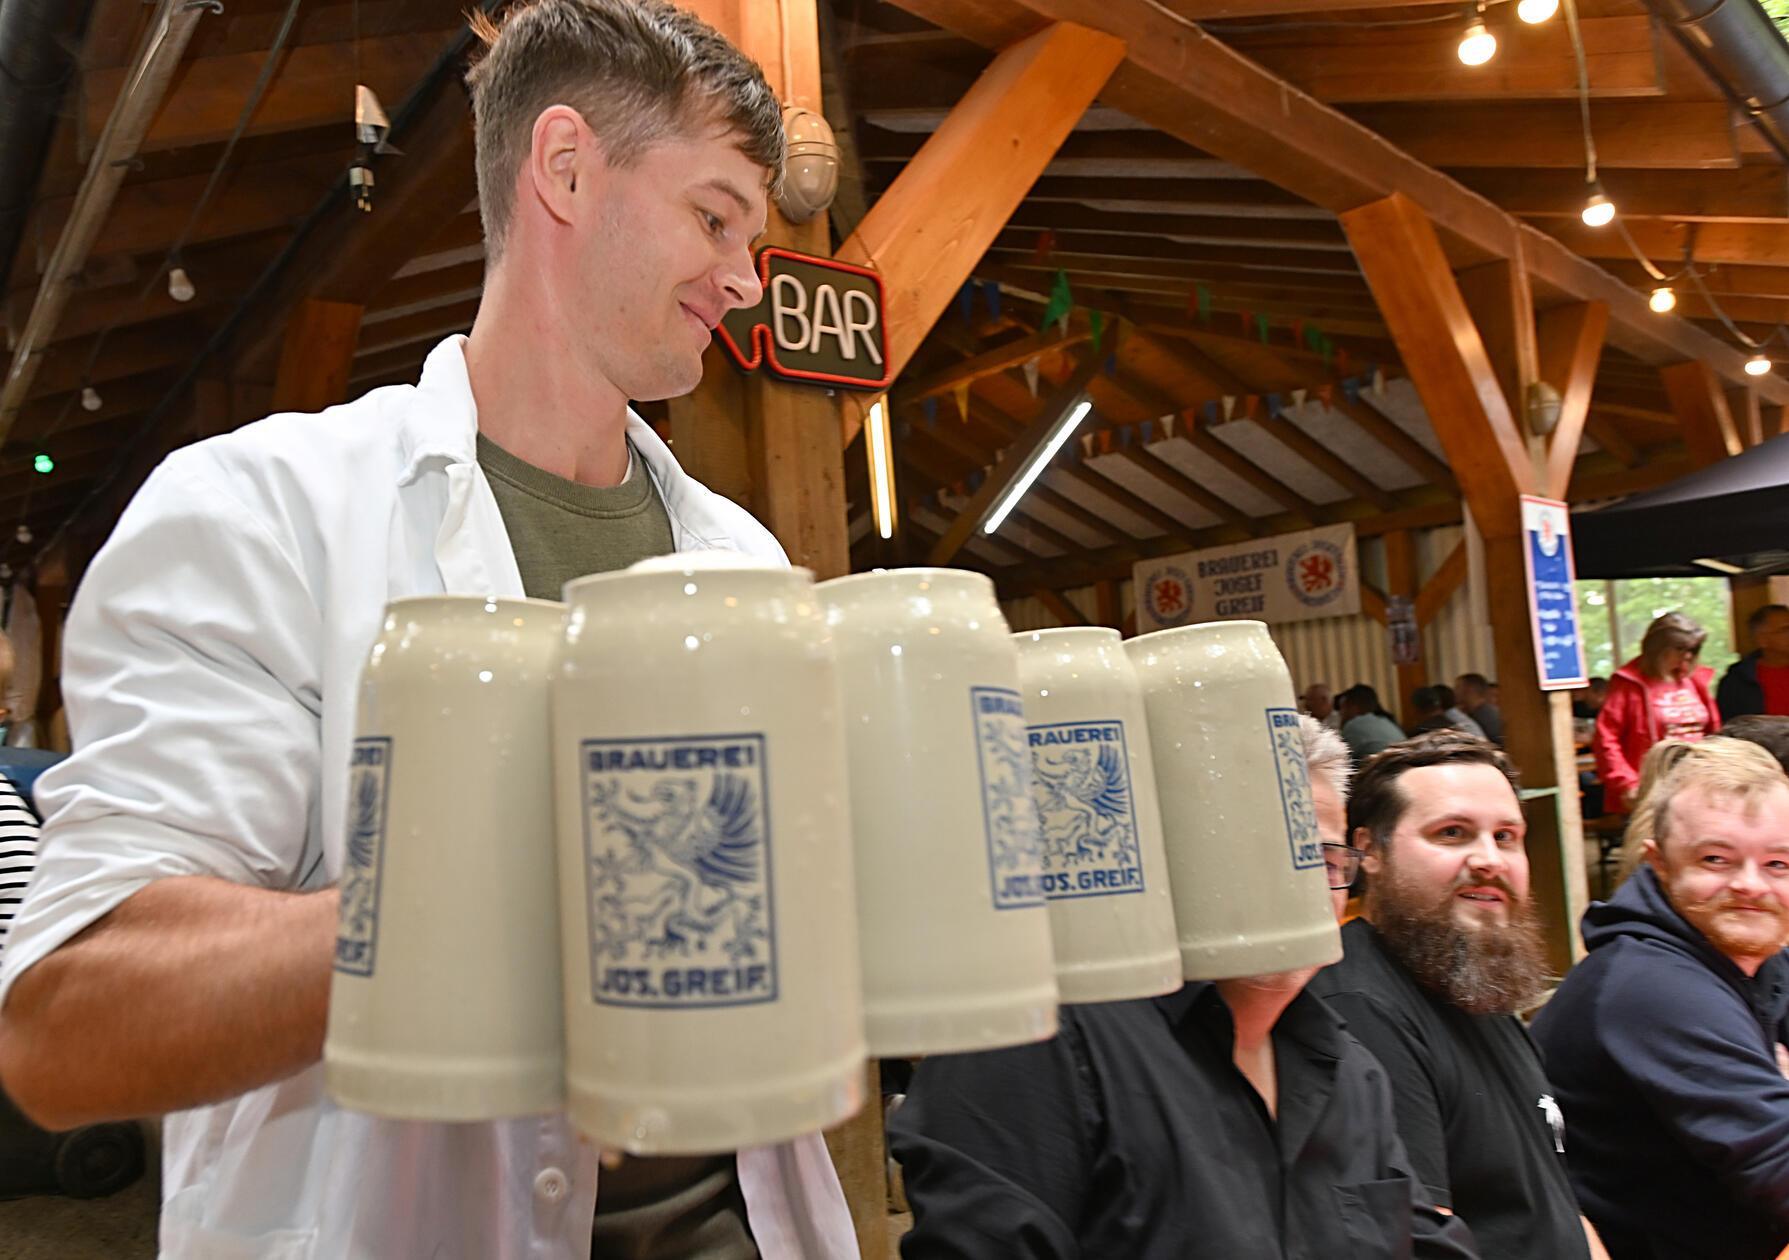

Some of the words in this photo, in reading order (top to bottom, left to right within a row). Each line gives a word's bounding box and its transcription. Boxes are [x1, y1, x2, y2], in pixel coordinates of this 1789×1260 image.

[771, 273, 883, 365] BAR
[1198, 550, 1279, 578] BRAUEREI
[1216, 595, 1265, 616] GREIF
[1027, 727, 1120, 747] RAUEREI
[589, 746, 755, 771] BRAUEREI
